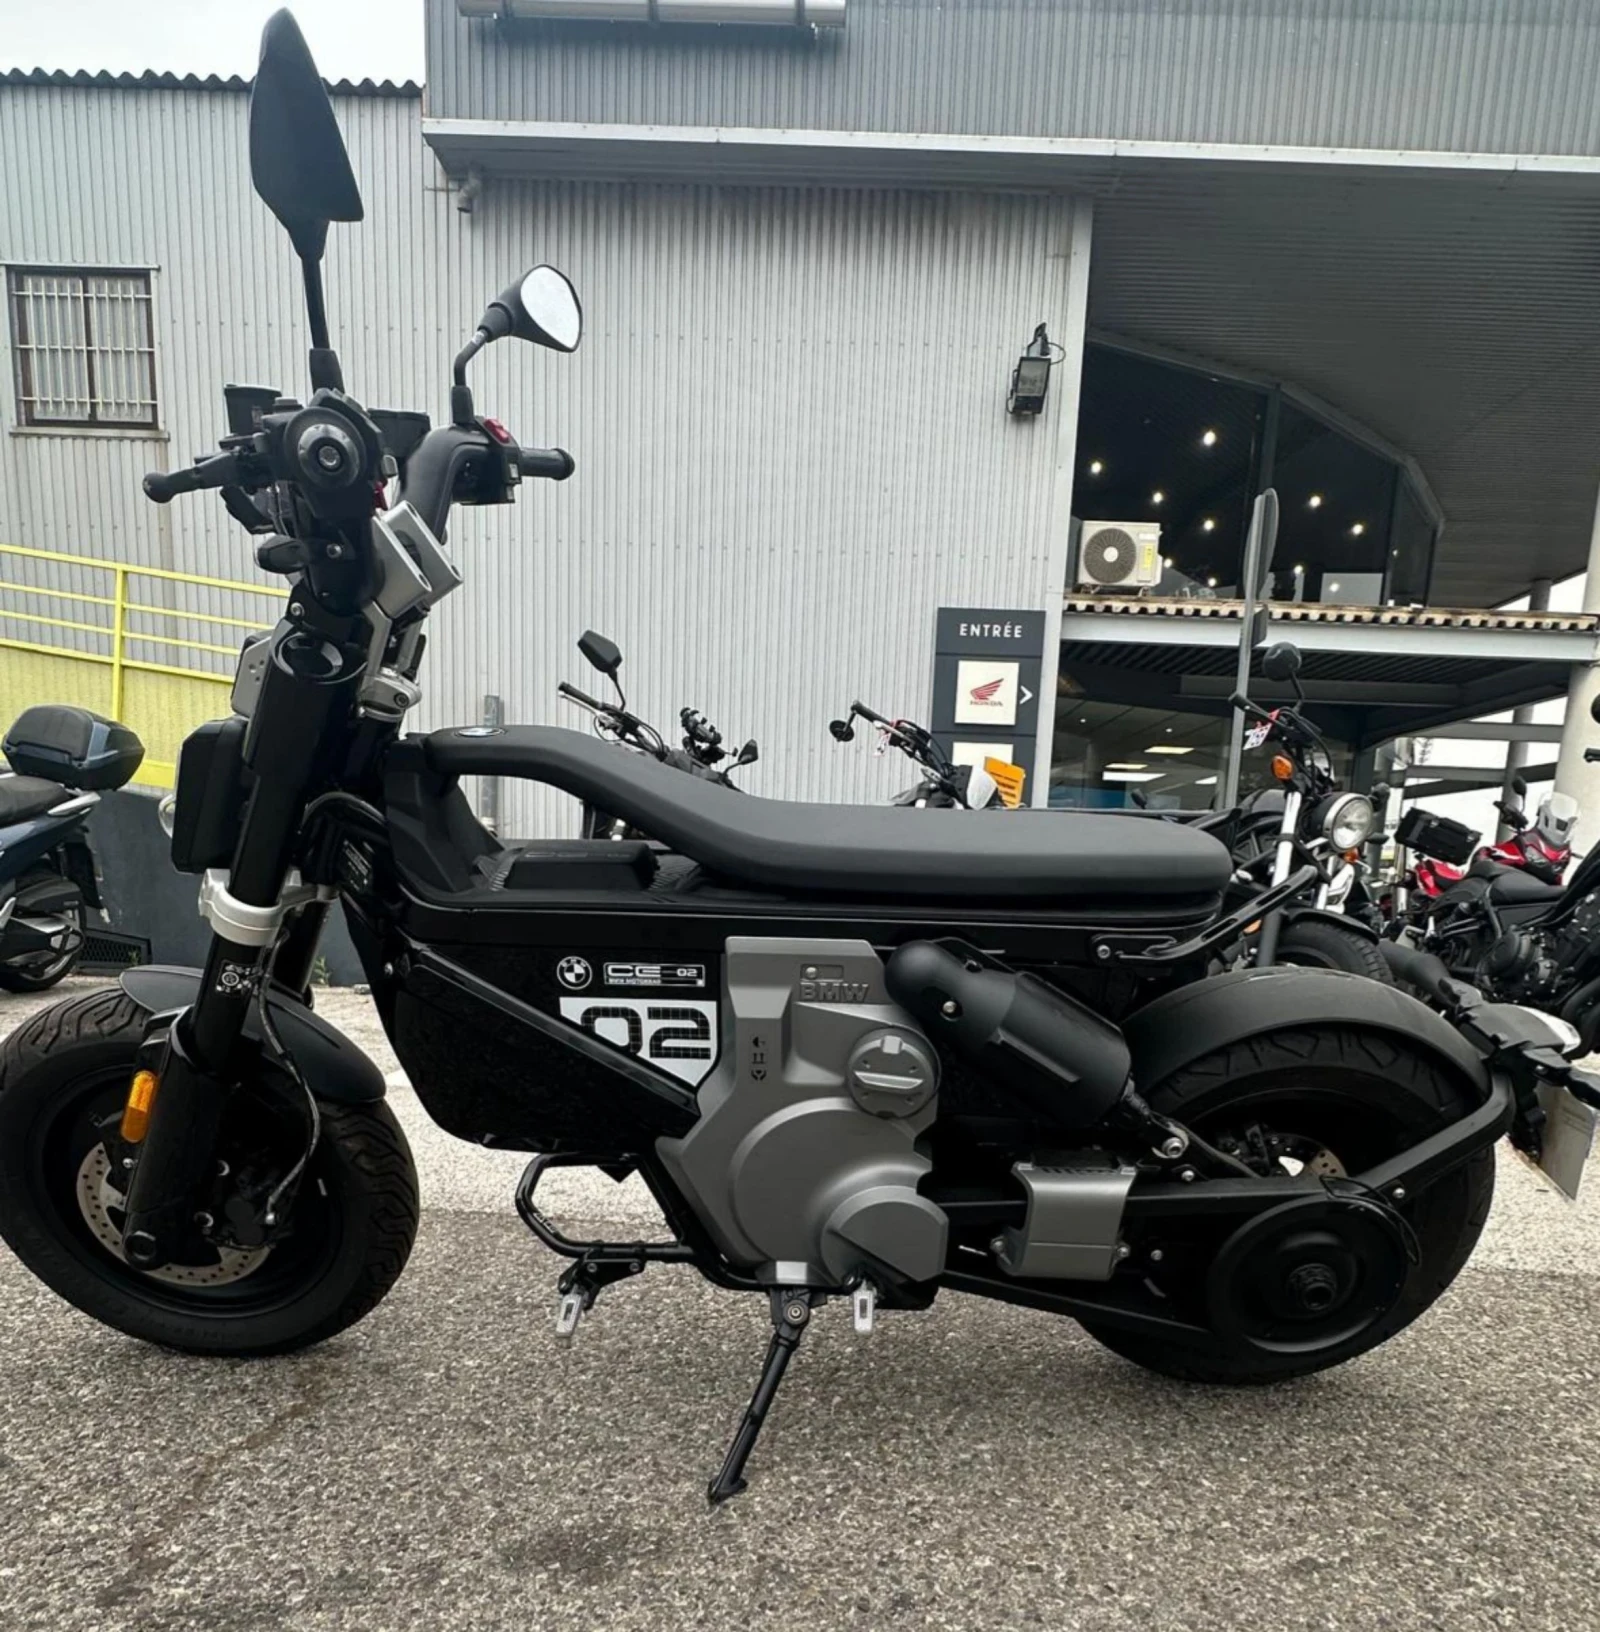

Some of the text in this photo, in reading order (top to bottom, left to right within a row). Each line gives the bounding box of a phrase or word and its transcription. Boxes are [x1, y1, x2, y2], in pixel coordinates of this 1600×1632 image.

[959, 621, 1023, 638] ENTRÉE
[676, 968, 698, 977] 02
[799, 982, 869, 1003] BMW
[580, 1006, 711, 1059] 02
